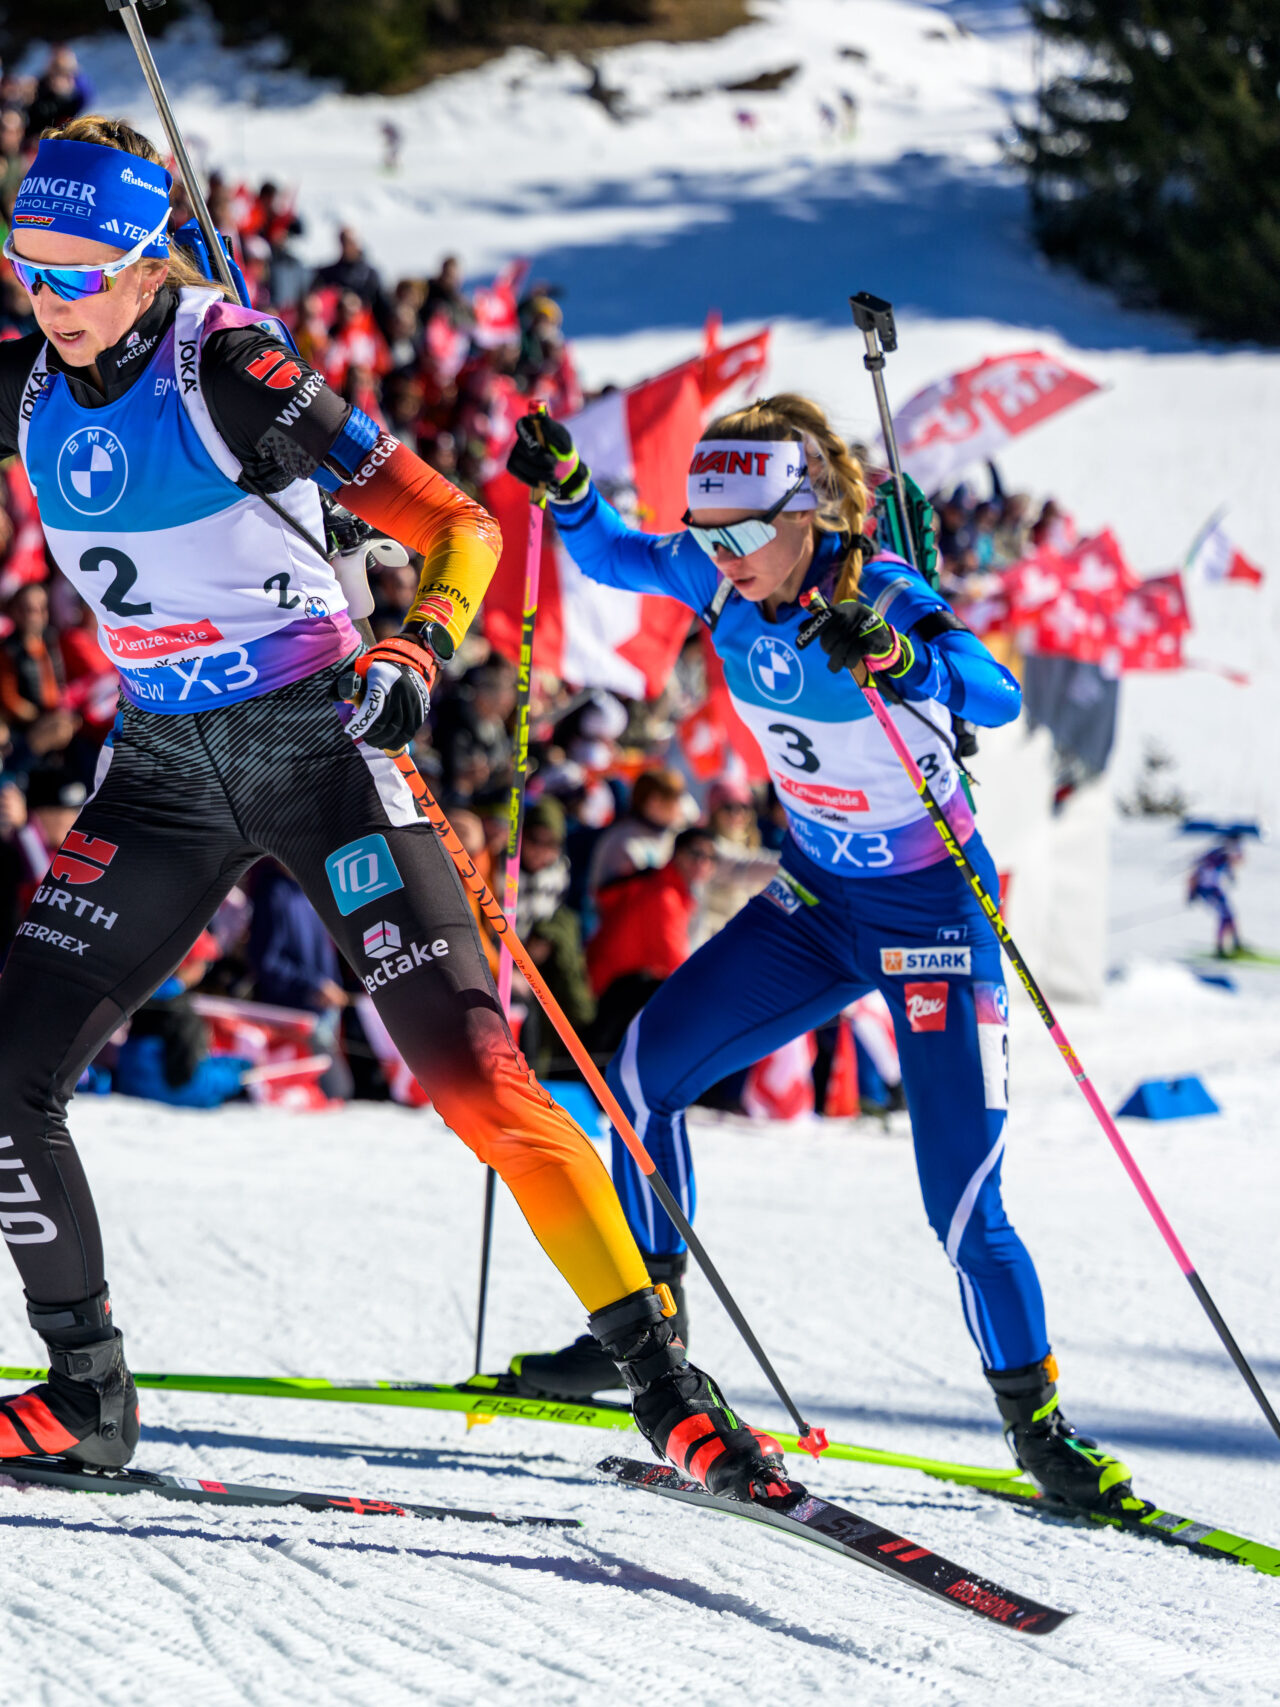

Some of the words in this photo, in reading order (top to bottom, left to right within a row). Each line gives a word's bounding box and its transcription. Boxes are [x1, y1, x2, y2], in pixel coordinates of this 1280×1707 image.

[17, 177, 97, 207] DINGER
[67, 431, 118, 455] BMW
[79, 546, 154, 618] 2
[263, 572, 301, 609] 2
[169, 645, 259, 701] X3
[768, 723, 821, 774] 3
[917, 753, 940, 781] 3
[822, 831, 894, 868] X3
[970, 874, 1012, 943] LEKI
[906, 953, 966, 969] STARK
[907, 993, 945, 1023] Rex
[472, 1399, 597, 1423] FISCHER
